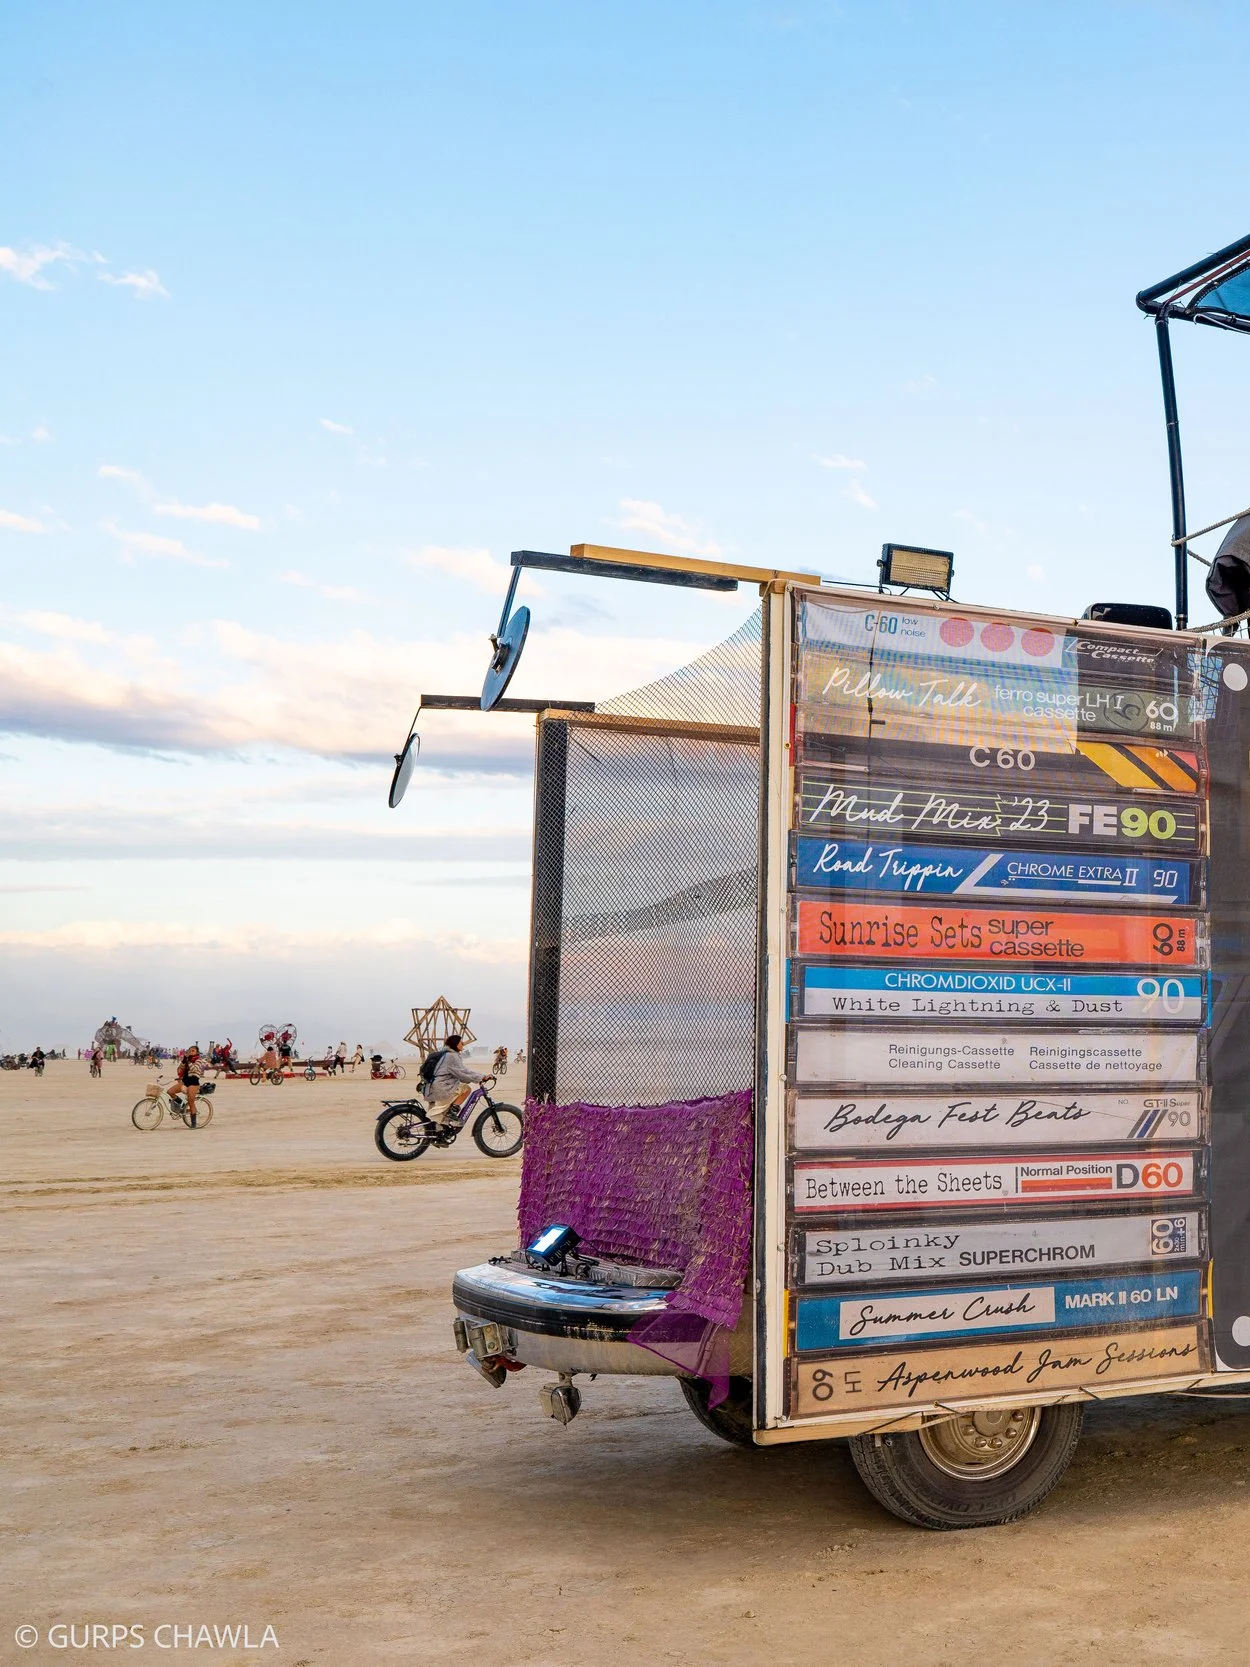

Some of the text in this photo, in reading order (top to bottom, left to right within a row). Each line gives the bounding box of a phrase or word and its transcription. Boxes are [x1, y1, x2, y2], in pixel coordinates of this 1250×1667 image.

[864, 614, 898, 635] C-60
[901, 616, 919, 626] low
[900, 628, 927, 638] noise
[1077, 641, 1139, 655] Compact
[1091, 650, 1155, 664] Cassette
[822, 666, 982, 708] Pillow Talk
[994, 685, 1033, 701] ferro
[1036, 691, 1084, 707] super
[1022, 705, 1097, 722] cassette
[1145, 700, 1177, 721] 60
[1149, 721, 1173, 732] 88 m
[809, 783, 905, 825] Mud
[911, 792, 1001, 831] Mix
[1067, 803, 1177, 840] FE90
[813, 842, 963, 891] Road Trippin
[1007, 862, 1075, 877] CHROME
[1078, 866, 1123, 880] EXTRA
[1152, 869, 1179, 888] 90
[819, 910, 982, 949] Sunrise Sets
[988, 918, 1055, 938] super
[989, 937, 1085, 958] cassette
[884, 972, 1072, 993] CHROMDIOXID UCX-II
[832, 995, 1125, 1016] White Lightning & Dust
[1136, 978, 1185, 1014] 90
[888, 1043, 1015, 1057] Reinigungs-Cassette
[888, 1058, 1001, 1071] Cleaning Cassette
[1029, 1060, 1163, 1072] Cassette de nettoyage
[824, 1099, 1092, 1141] Bodega Fest Beats
[1167, 1110, 1192, 1127] 90
[1020, 1163, 1113, 1178] Normal Position
[1115, 1162, 1184, 1190] D60
[806, 1171, 1003, 1199] Between the Sheets
[816, 1233, 961, 1256] Sploinky
[1152, 1219, 1174, 1254] 60
[816, 1254, 947, 1278] Dub Mix
[959, 1243, 1096, 1268] SUPERCHROM
[1064, 1292, 1115, 1309] MARK
[1130, 1289, 1152, 1304] 60
[1156, 1287, 1179, 1302] LN
[849, 1293, 1036, 1337] Summer Crush
[877, 1341, 1198, 1397] Aspenwood Jam Sessions
